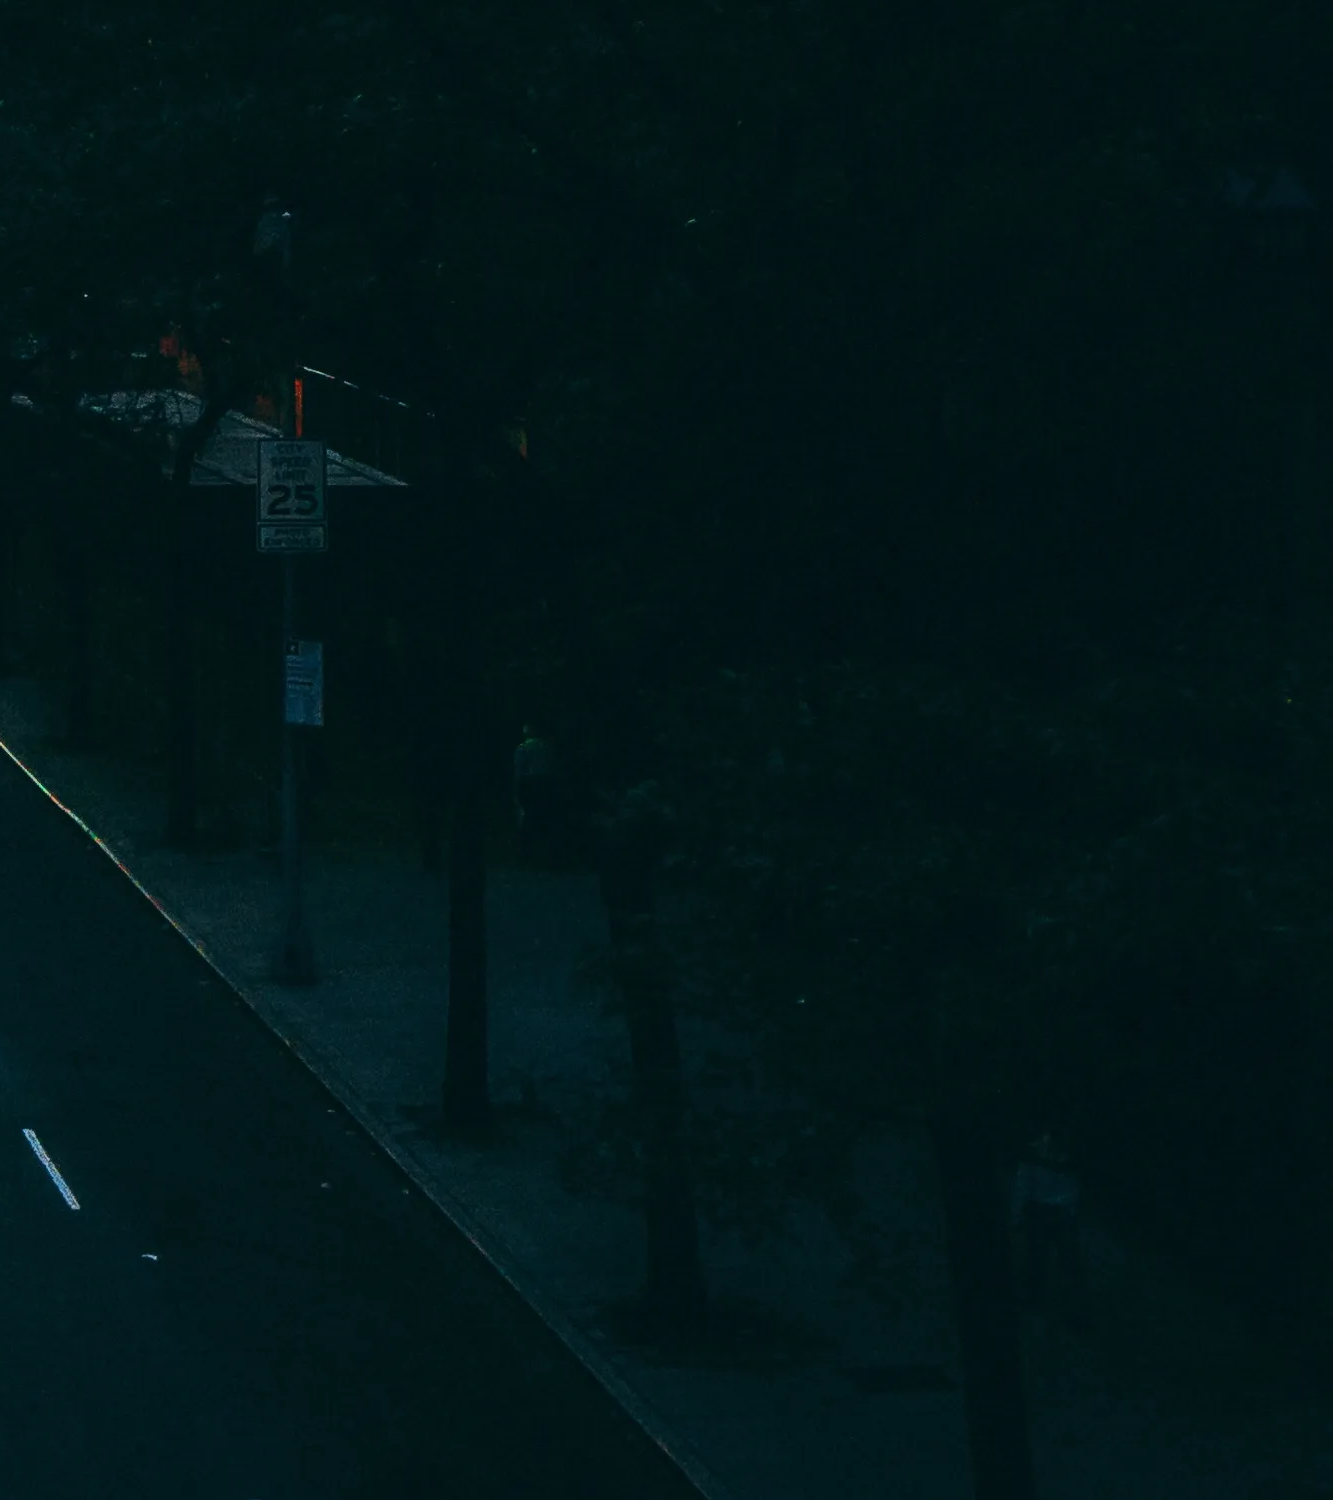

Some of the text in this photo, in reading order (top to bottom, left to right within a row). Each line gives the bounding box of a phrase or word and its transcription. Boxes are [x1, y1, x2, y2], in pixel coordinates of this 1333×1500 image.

[276, 444, 306, 454] CITY
[271, 456, 312, 467] SPEED
[275, 469, 307, 481] LIMIT
[267, 485, 319, 515] 25
